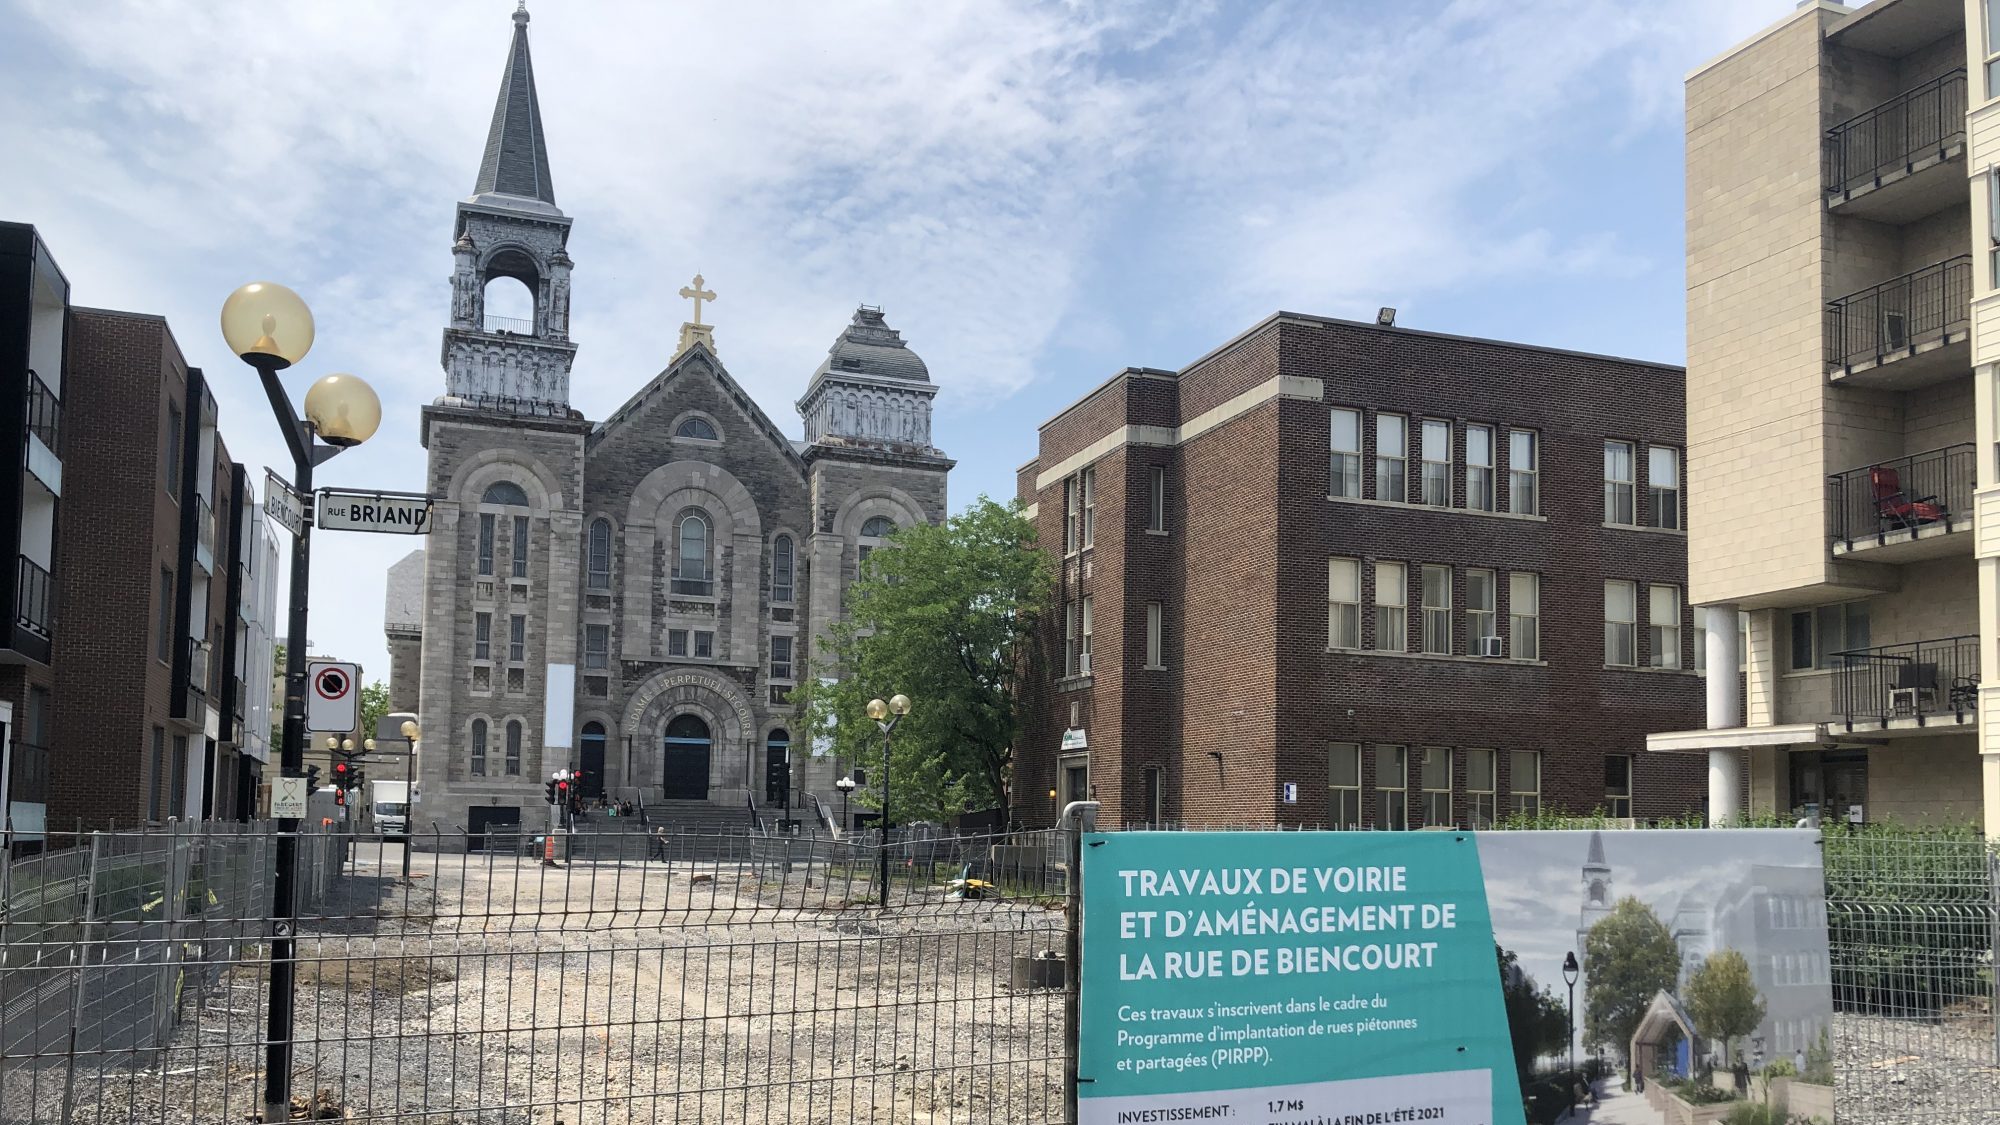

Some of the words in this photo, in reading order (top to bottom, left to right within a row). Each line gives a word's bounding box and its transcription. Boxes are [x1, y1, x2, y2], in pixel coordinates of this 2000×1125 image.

[271, 495, 302, 534] BIENCOURT
[327, 507, 346, 517] RUE
[350, 504, 427, 526] BRIAND
[1118, 868, 1263, 897] TRAVAUX
[1270, 867, 1307, 894] DE
[1313, 866, 1406, 893] VOIRIE
[1120, 911, 1157, 939] ET
[1165, 900, 1415, 938] D’AMÉNAGEMENT
[1421, 903, 1456, 929] DE
[1119, 952, 1157, 981] LA
[1164, 950, 1223, 979] RUE
[1231, 948, 1269, 976] DE
[1277, 942, 1438, 974] BIENCOURT
[1117, 1005, 1147, 1021] Ces
[1150, 1007, 1204, 1020] travaux
[1285, 997, 1316, 1014] dans
[1319, 995, 1330, 1011] le
[1333, 993, 1368, 1011] cadre
[1371, 992, 1388, 1008] du
[1117, 1030, 1204, 1050] Programme
[1308, 1019, 1323, 1035] de
[1327, 1022, 1353, 1034] rues
[1356, 1016, 1418, 1036] piétonnes
[1116, 1058, 1132, 1071] et
[1136, 1052, 1207, 1074] partagées
[1211, 1046, 1273, 1070] (PIRPP).
[1117, 1104, 1230, 1124] INVESTISSEMENT
[1267, 1100, 1285, 1114] 1,7
[1287, 1099, 1304, 1112] M$
[1344, 1115, 1364, 1125] FIN
[1366, 1113, 1382, 1125] DE
[1417, 1107, 1444, 1120] 2021
